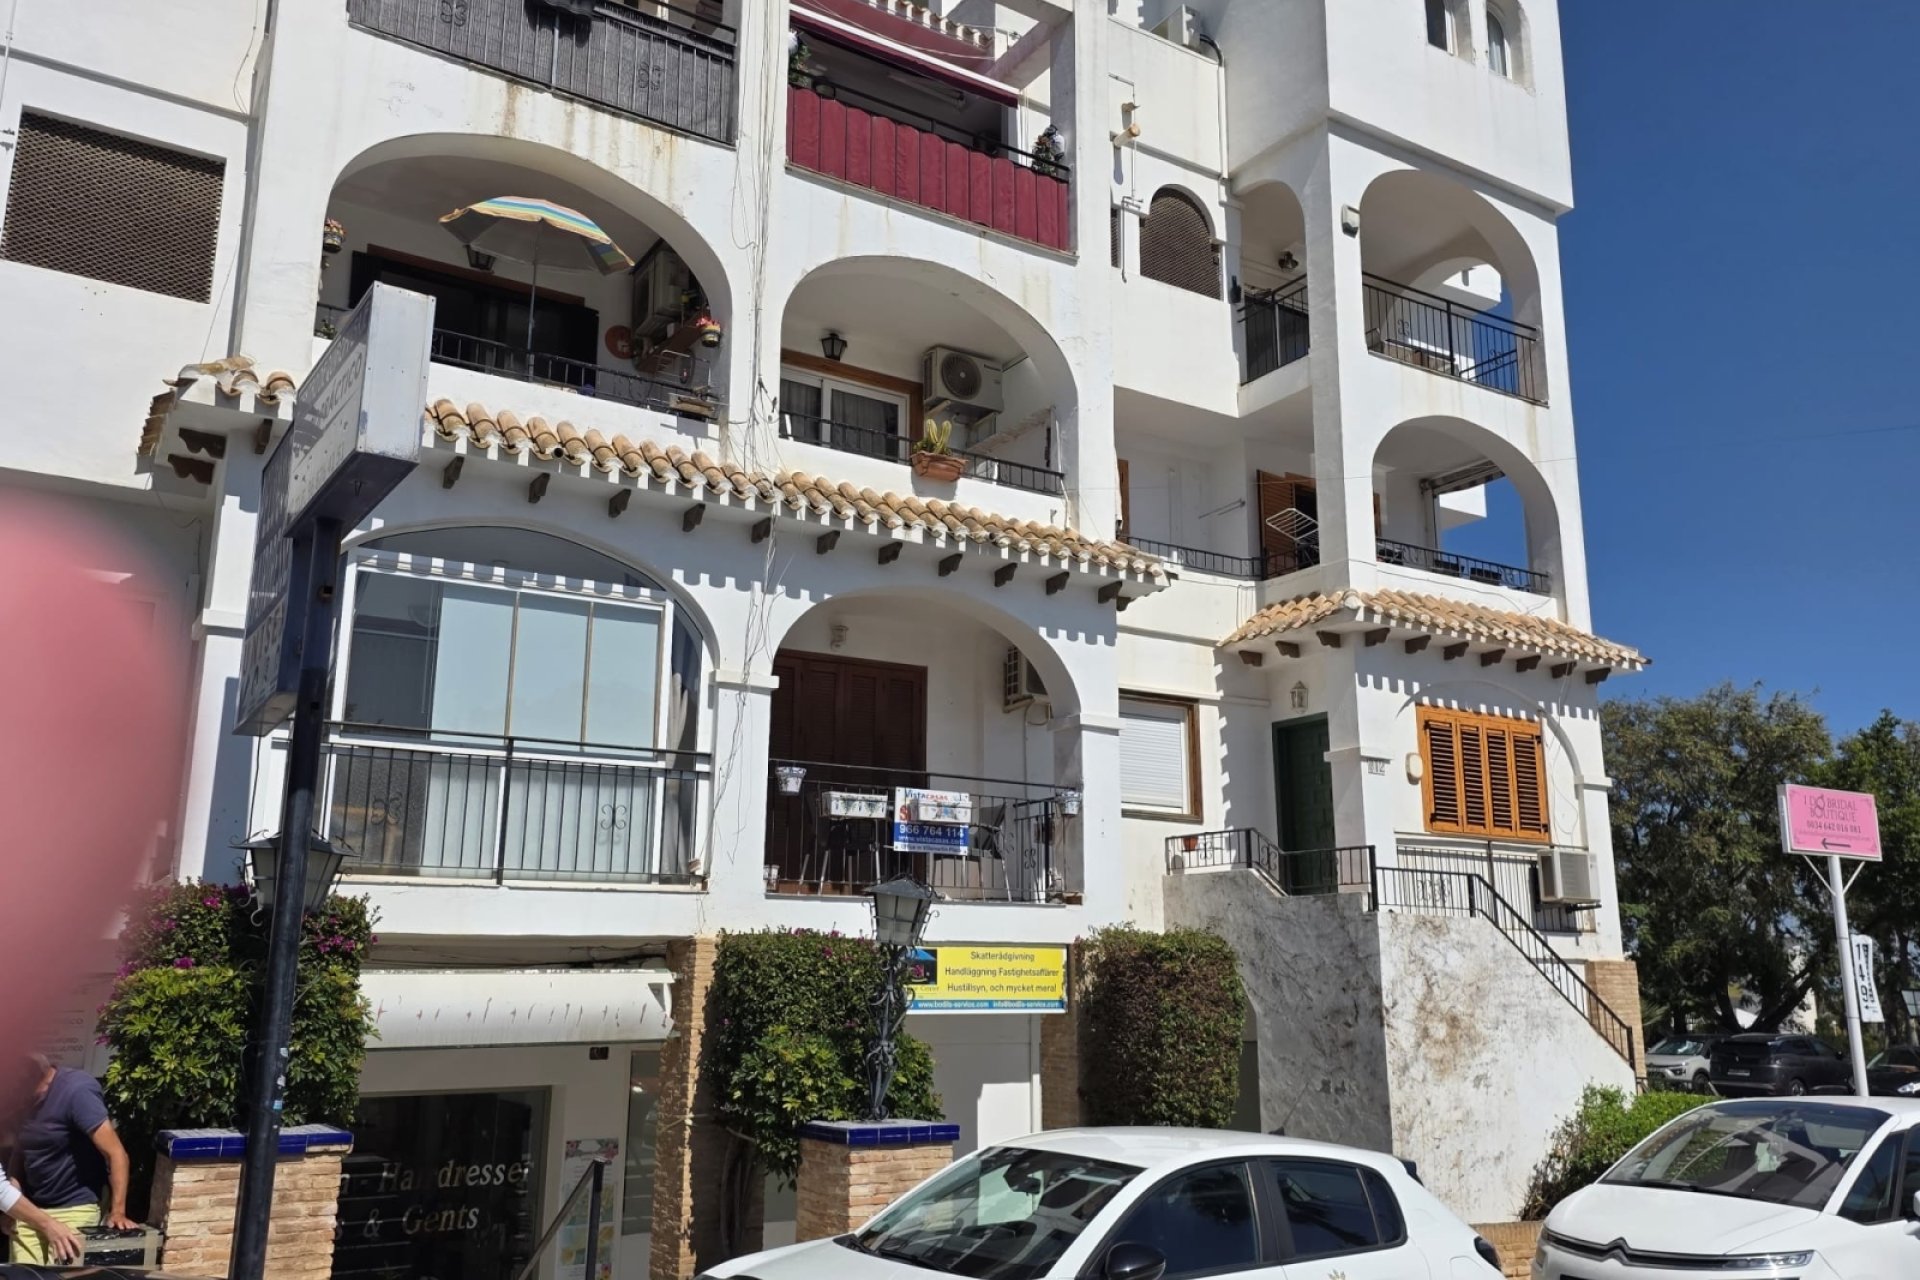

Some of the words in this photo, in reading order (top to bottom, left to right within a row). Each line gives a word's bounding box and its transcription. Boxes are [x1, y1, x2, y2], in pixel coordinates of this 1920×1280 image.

[1827, 797, 1858, 811] BRIDAL
[1810, 807, 1857, 823] BOUTIQUE
[899, 824, 920, 834] 966
[923, 825, 942, 836] 764
[970, 951, 1035, 962] Skatterådgivning
[945, 966, 997, 978] Handläggning
[998, 967, 1059, 978] Fastighetsaffärer
[947, 983, 988, 994] Hustillsyn,
[989, 983, 1004, 992] och
[1005, 984, 1034, 994] mycket
[377, 1158, 535, 1194] Hadresser
[402, 1205, 480, 1237] Gents
